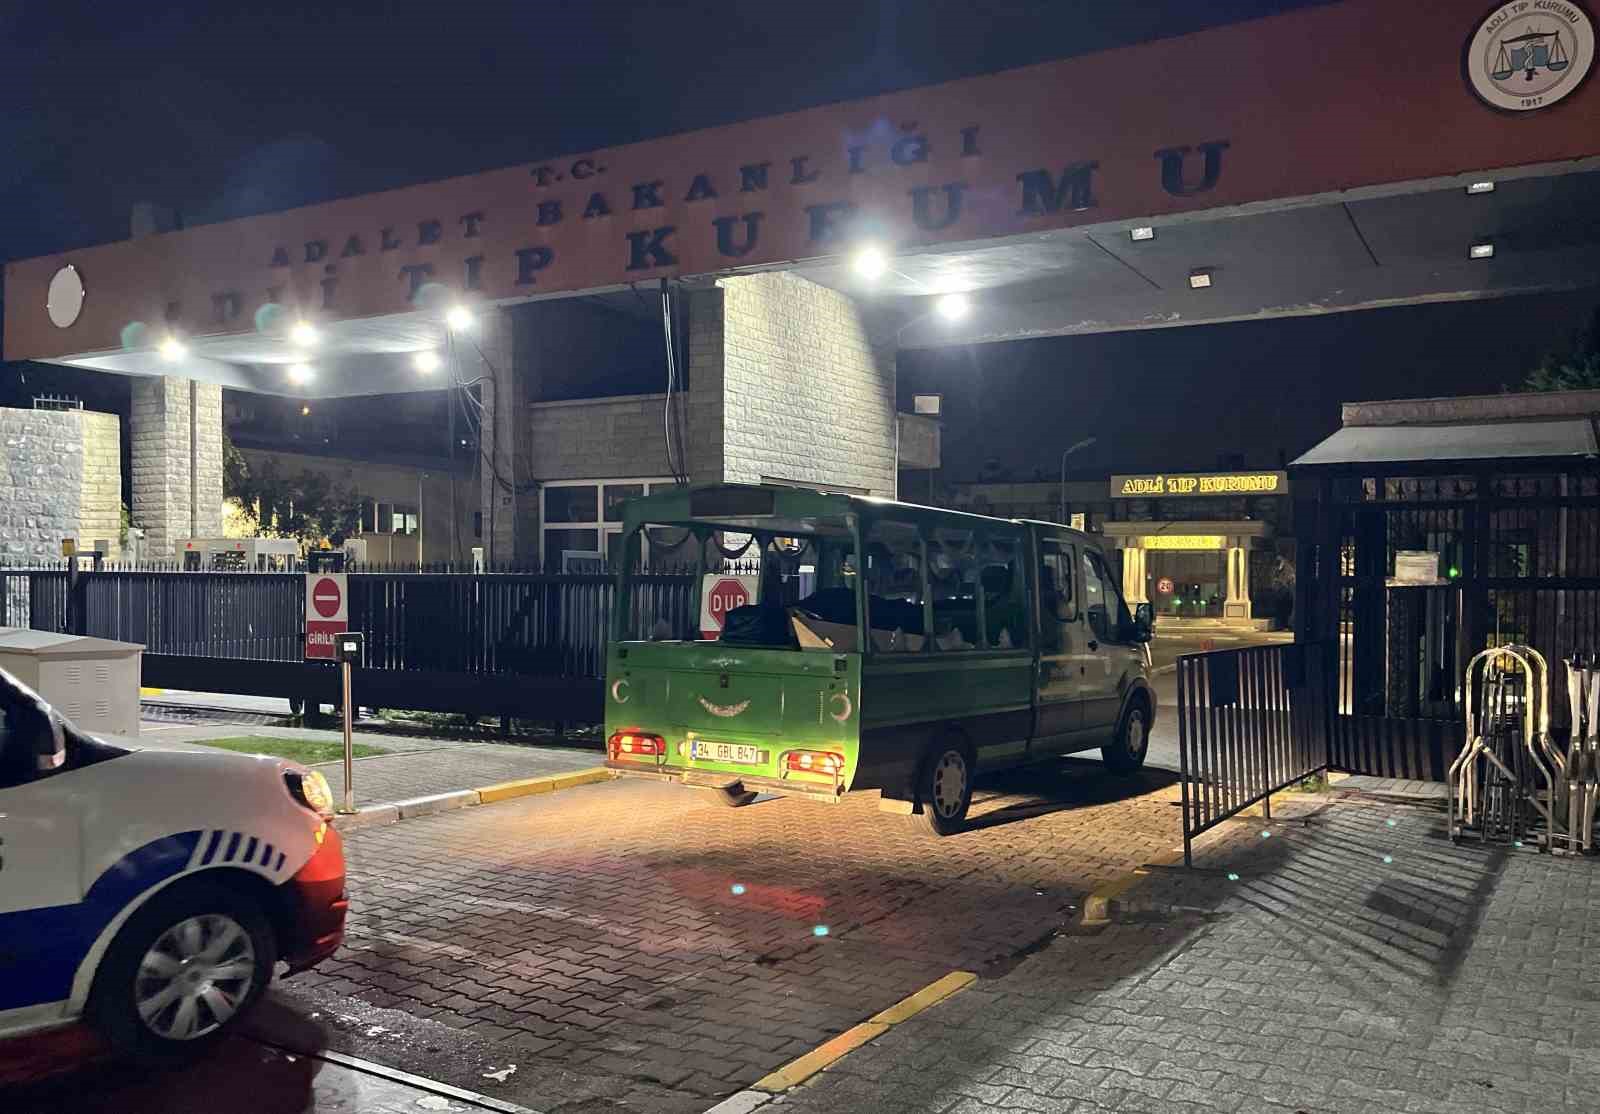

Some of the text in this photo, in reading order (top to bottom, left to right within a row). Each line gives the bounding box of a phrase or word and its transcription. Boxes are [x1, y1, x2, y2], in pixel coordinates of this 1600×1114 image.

[1511, 2, 1529, 14] TIP
[1534, 0, 1581, 24] KURUMU
[530, 160, 607, 186] T.C.
[270, 123, 981, 267] ADALET BAKANLIĞI
[1121, 475, 1279, 494] ADLİ TIP KURUMU
[698, 743, 755, 760] 34 GBL 847
